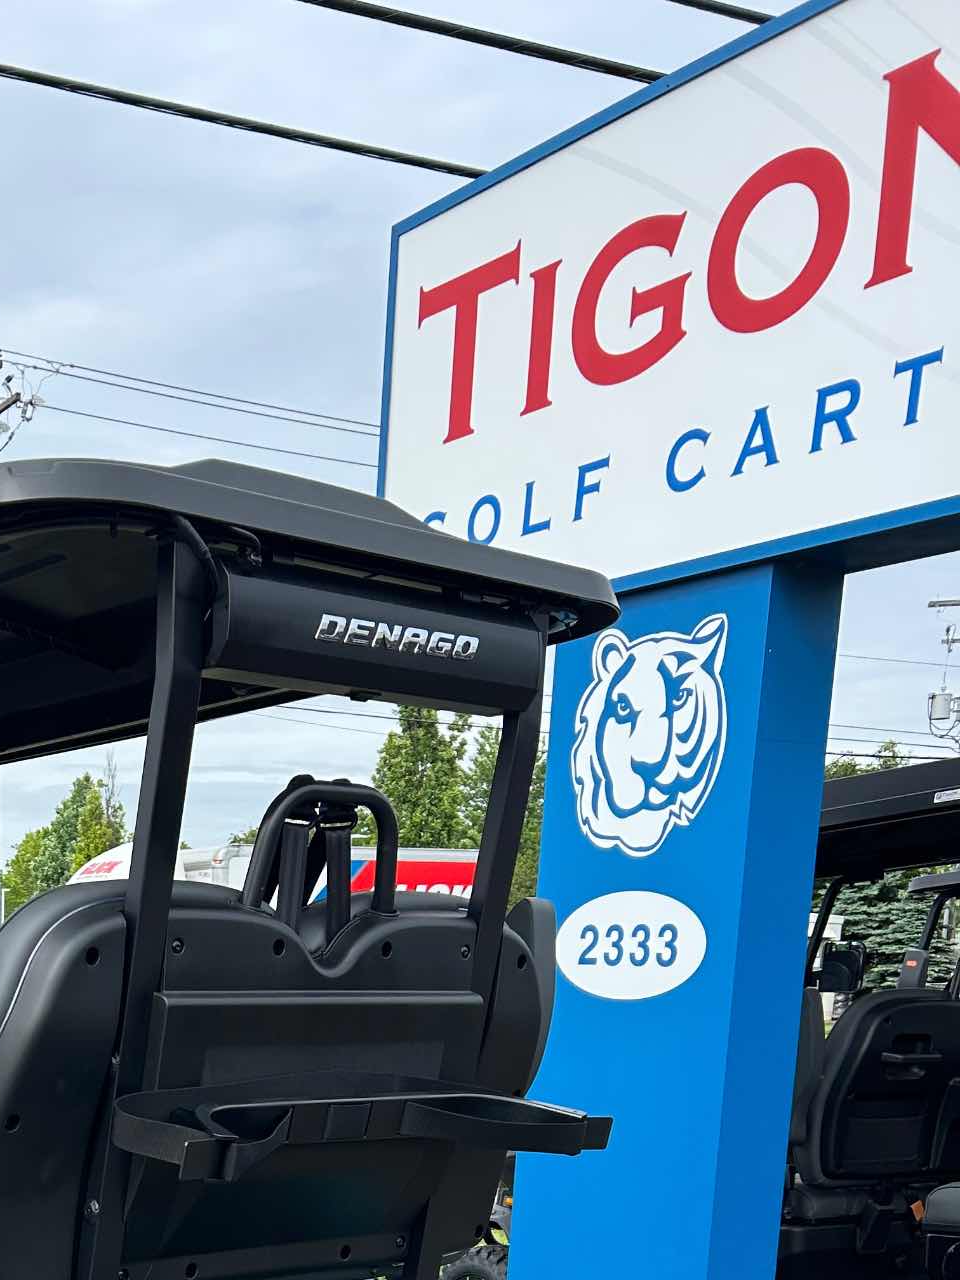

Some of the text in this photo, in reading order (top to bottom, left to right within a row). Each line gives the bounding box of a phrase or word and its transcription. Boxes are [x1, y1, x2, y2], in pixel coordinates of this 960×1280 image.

[423, 454, 611, 546] OLF
[314, 613, 480, 660] DENAGO
[578, 923, 679, 967] 2333
